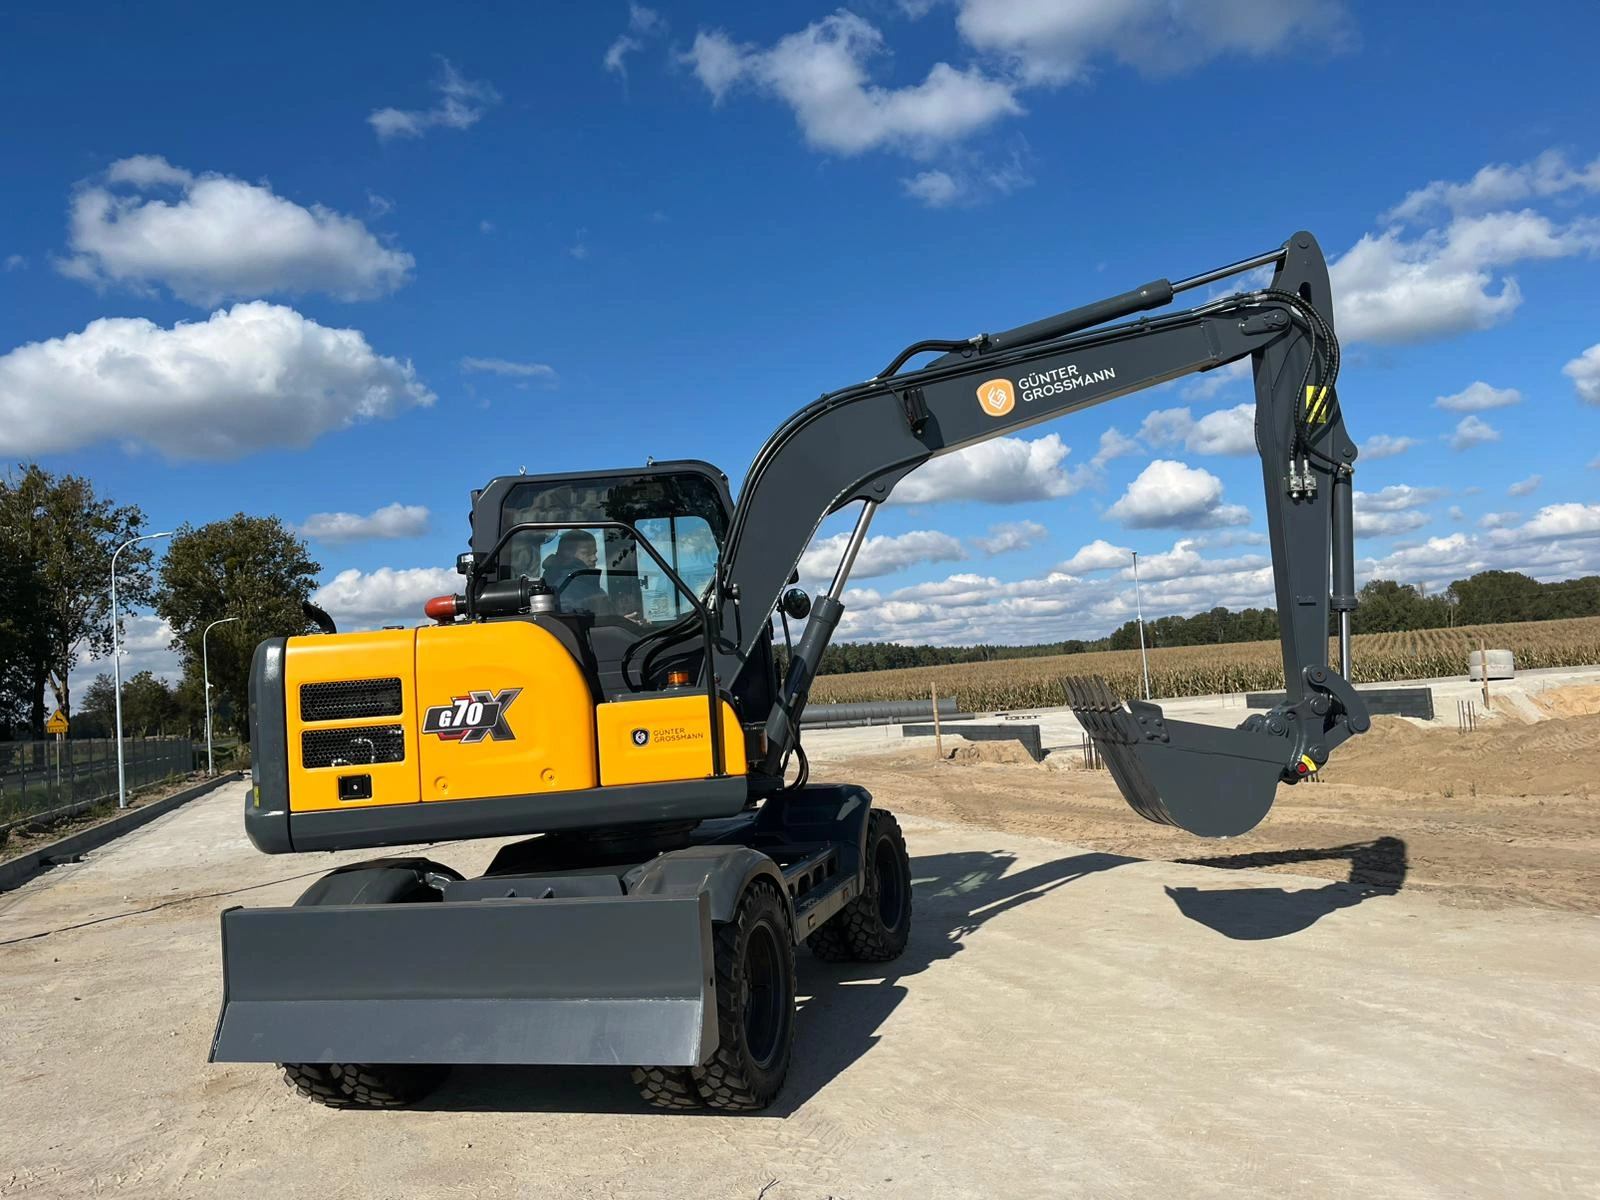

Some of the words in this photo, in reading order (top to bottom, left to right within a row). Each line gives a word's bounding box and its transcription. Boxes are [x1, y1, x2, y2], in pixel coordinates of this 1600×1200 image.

[1018, 365, 1079, 390] GÜNTER
[1022, 367, 1116, 401] GROSSMANN
[438, 699, 484, 728] G70
[653, 732, 704, 743] GROSSMANN
